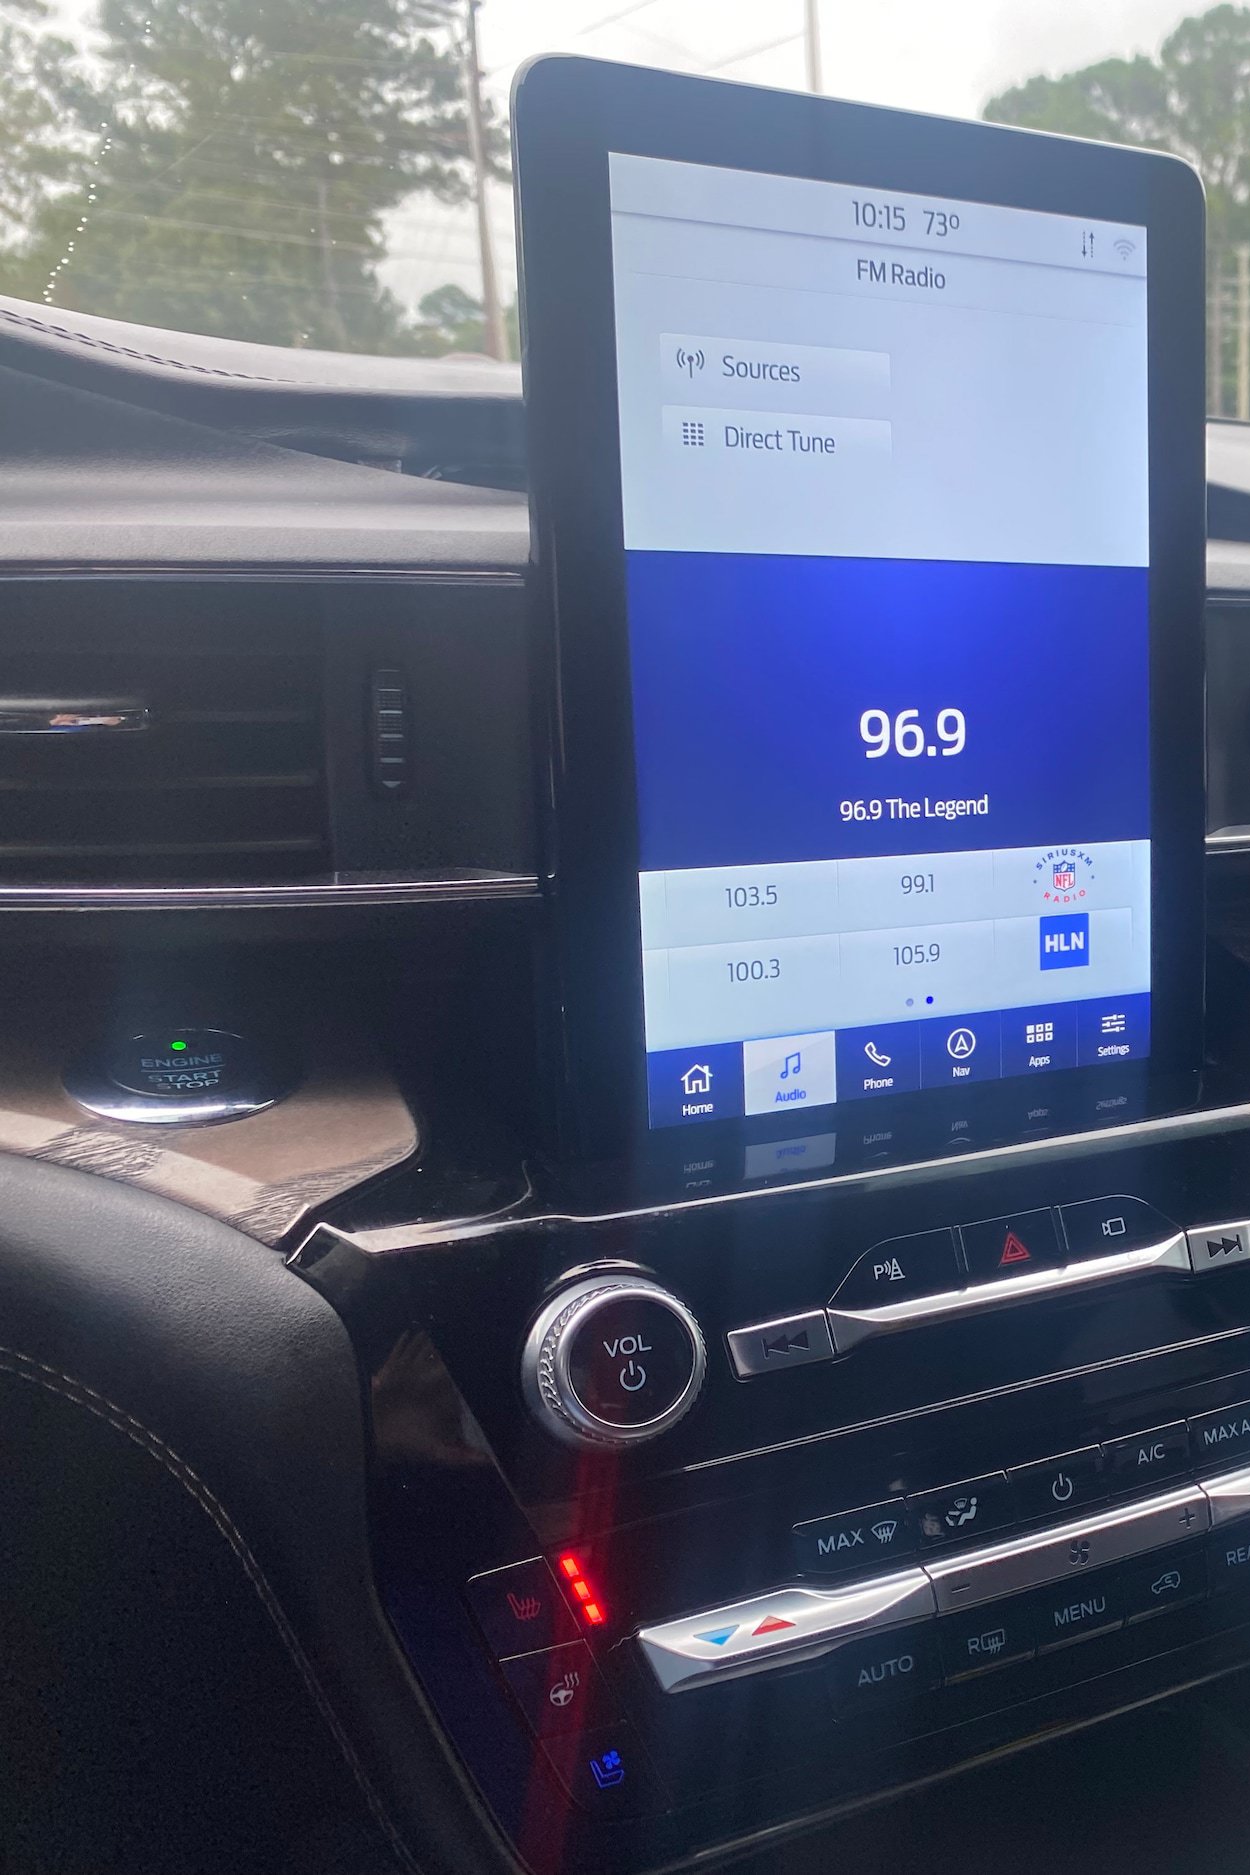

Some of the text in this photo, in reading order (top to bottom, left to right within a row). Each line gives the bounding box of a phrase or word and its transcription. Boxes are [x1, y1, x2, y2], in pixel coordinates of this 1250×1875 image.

[852, 200, 906, 233] 10:15
[856, 258, 946, 290] FM Radio
[721, 355, 801, 384] Sources
[724, 425, 836, 454] Direct Tune
[858, 708, 967, 758] 96.9
[839, 794, 989, 822] 96.9 The Legend
[1036, 848, 1093, 870] SIRIUSXM
[900, 874, 935, 895] 99.1
[1055, 873, 1074, 889] NFL
[725, 885, 778, 909] 103.5
[1043, 889, 1086, 903] RADIO
[1044, 931, 1085, 953] HLN
[893, 943, 941, 966] 105.9
[727, 958, 781, 983] 100.3
[141, 1053, 223, 1067] ENGINE
[1028, 1054, 1051, 1068] Apps
[1097, 1042, 1130, 1058] Settings
[148, 1069, 222, 1083] START
[863, 1075, 894, 1090] Phone
[952, 1064, 971, 1078] Nav
[157, 1078, 219, 1091] STOP
[775, 1087, 807, 1102] Audio
[682, 1101, 714, 1116] Home
[602, 1334, 652, 1358] VOL
[1203, 1423, 1240, 1446] MAX
[1136, 1442, 1166, 1465] A/C
[817, 1527, 865, 1556] MAX
[1053, 1597, 1107, 1627] MENU
[857, 1654, 914, 1687] AUTO
